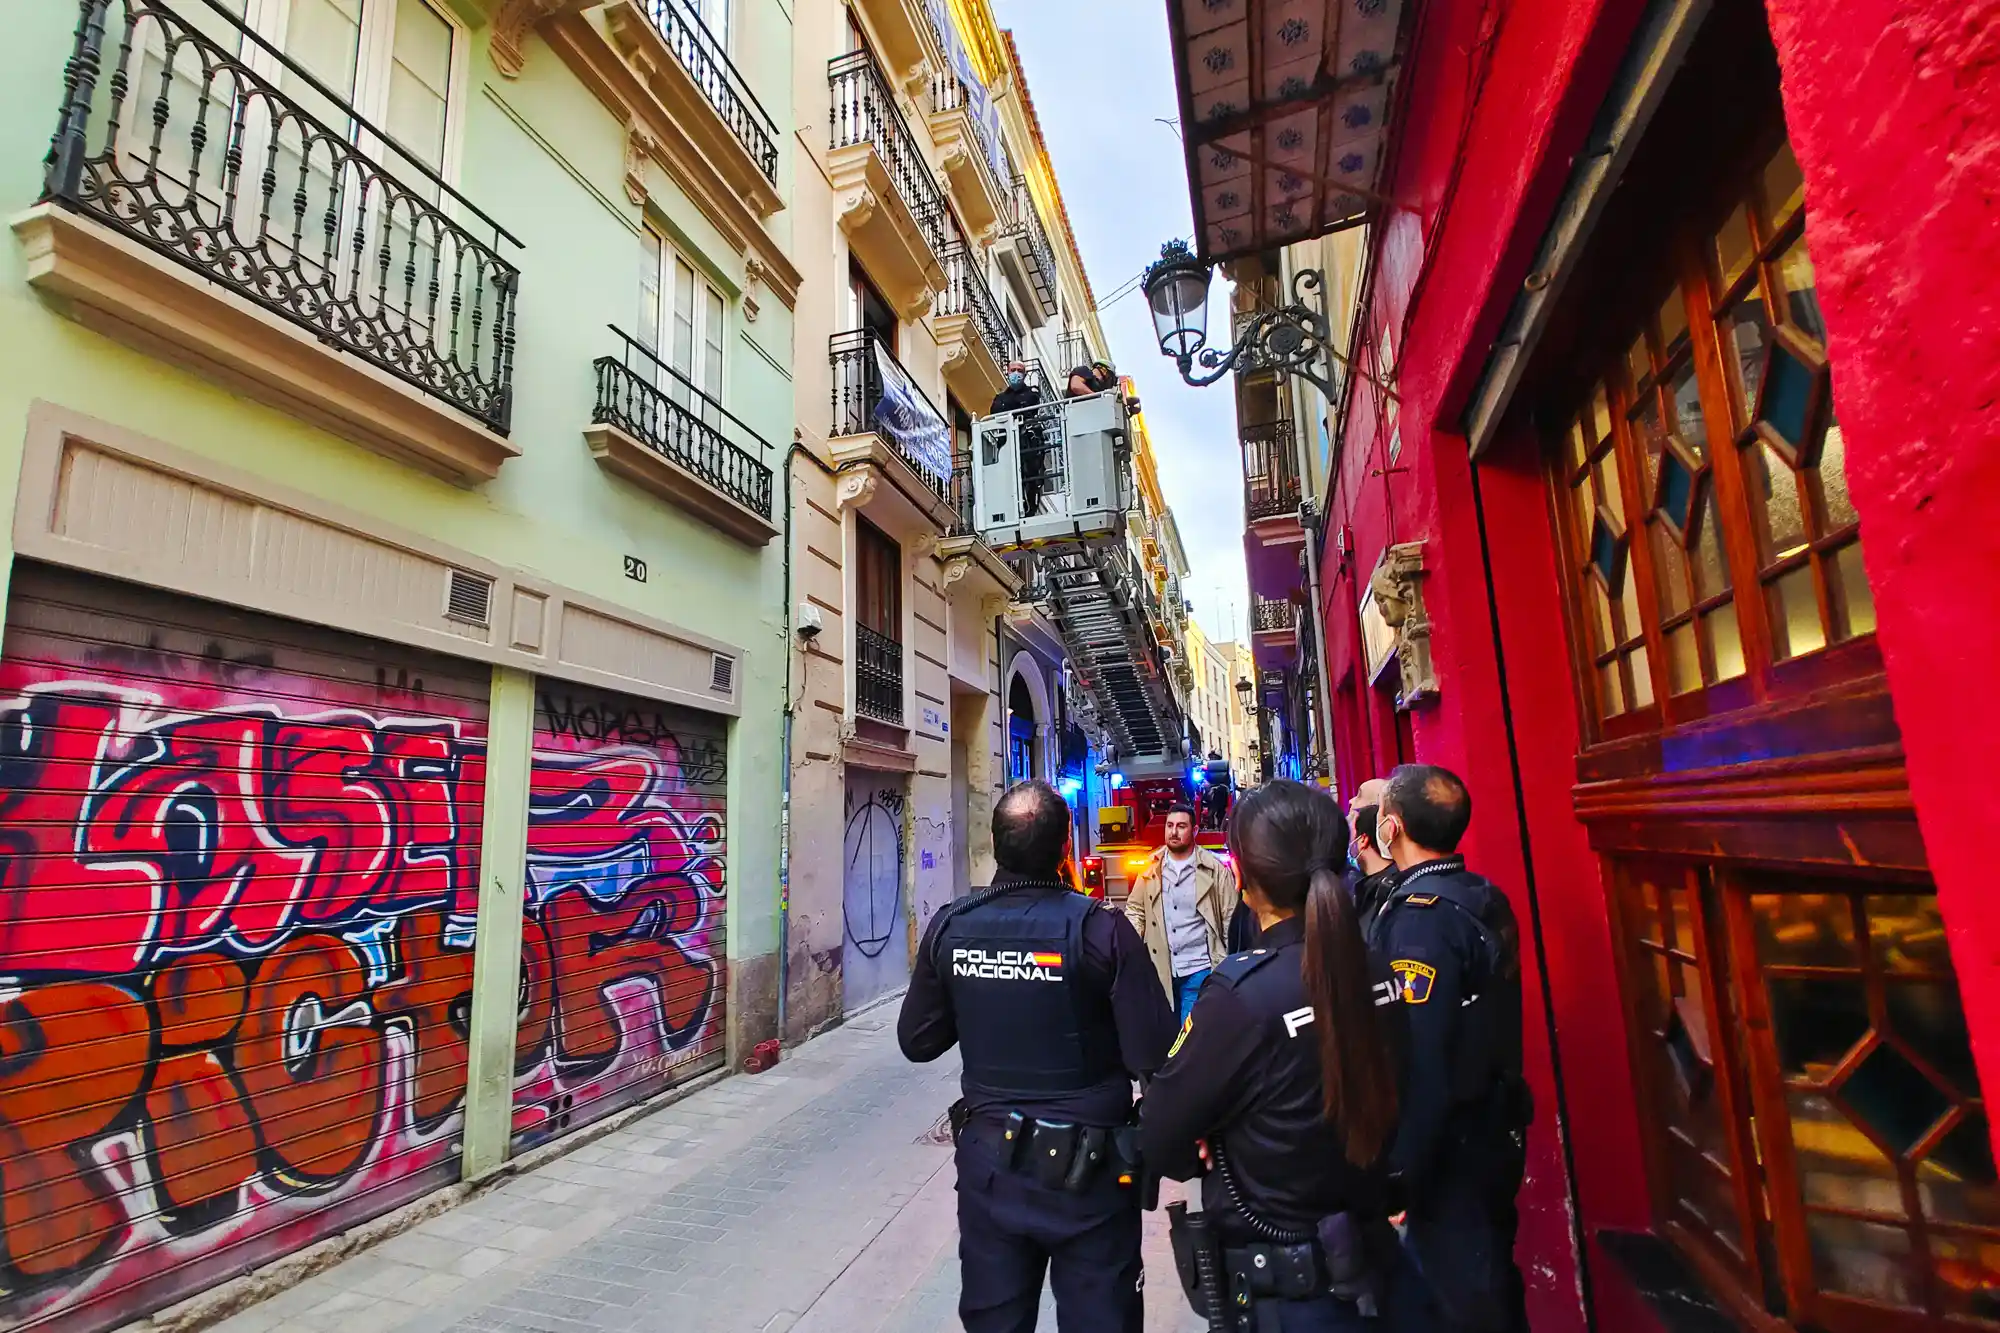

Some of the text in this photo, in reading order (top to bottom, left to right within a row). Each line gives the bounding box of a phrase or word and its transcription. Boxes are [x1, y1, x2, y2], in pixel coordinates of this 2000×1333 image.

[624, 558, 646, 581] 20
[952, 948, 1038, 966] POLICIA
[953, 963, 1063, 982] NACIONAL
